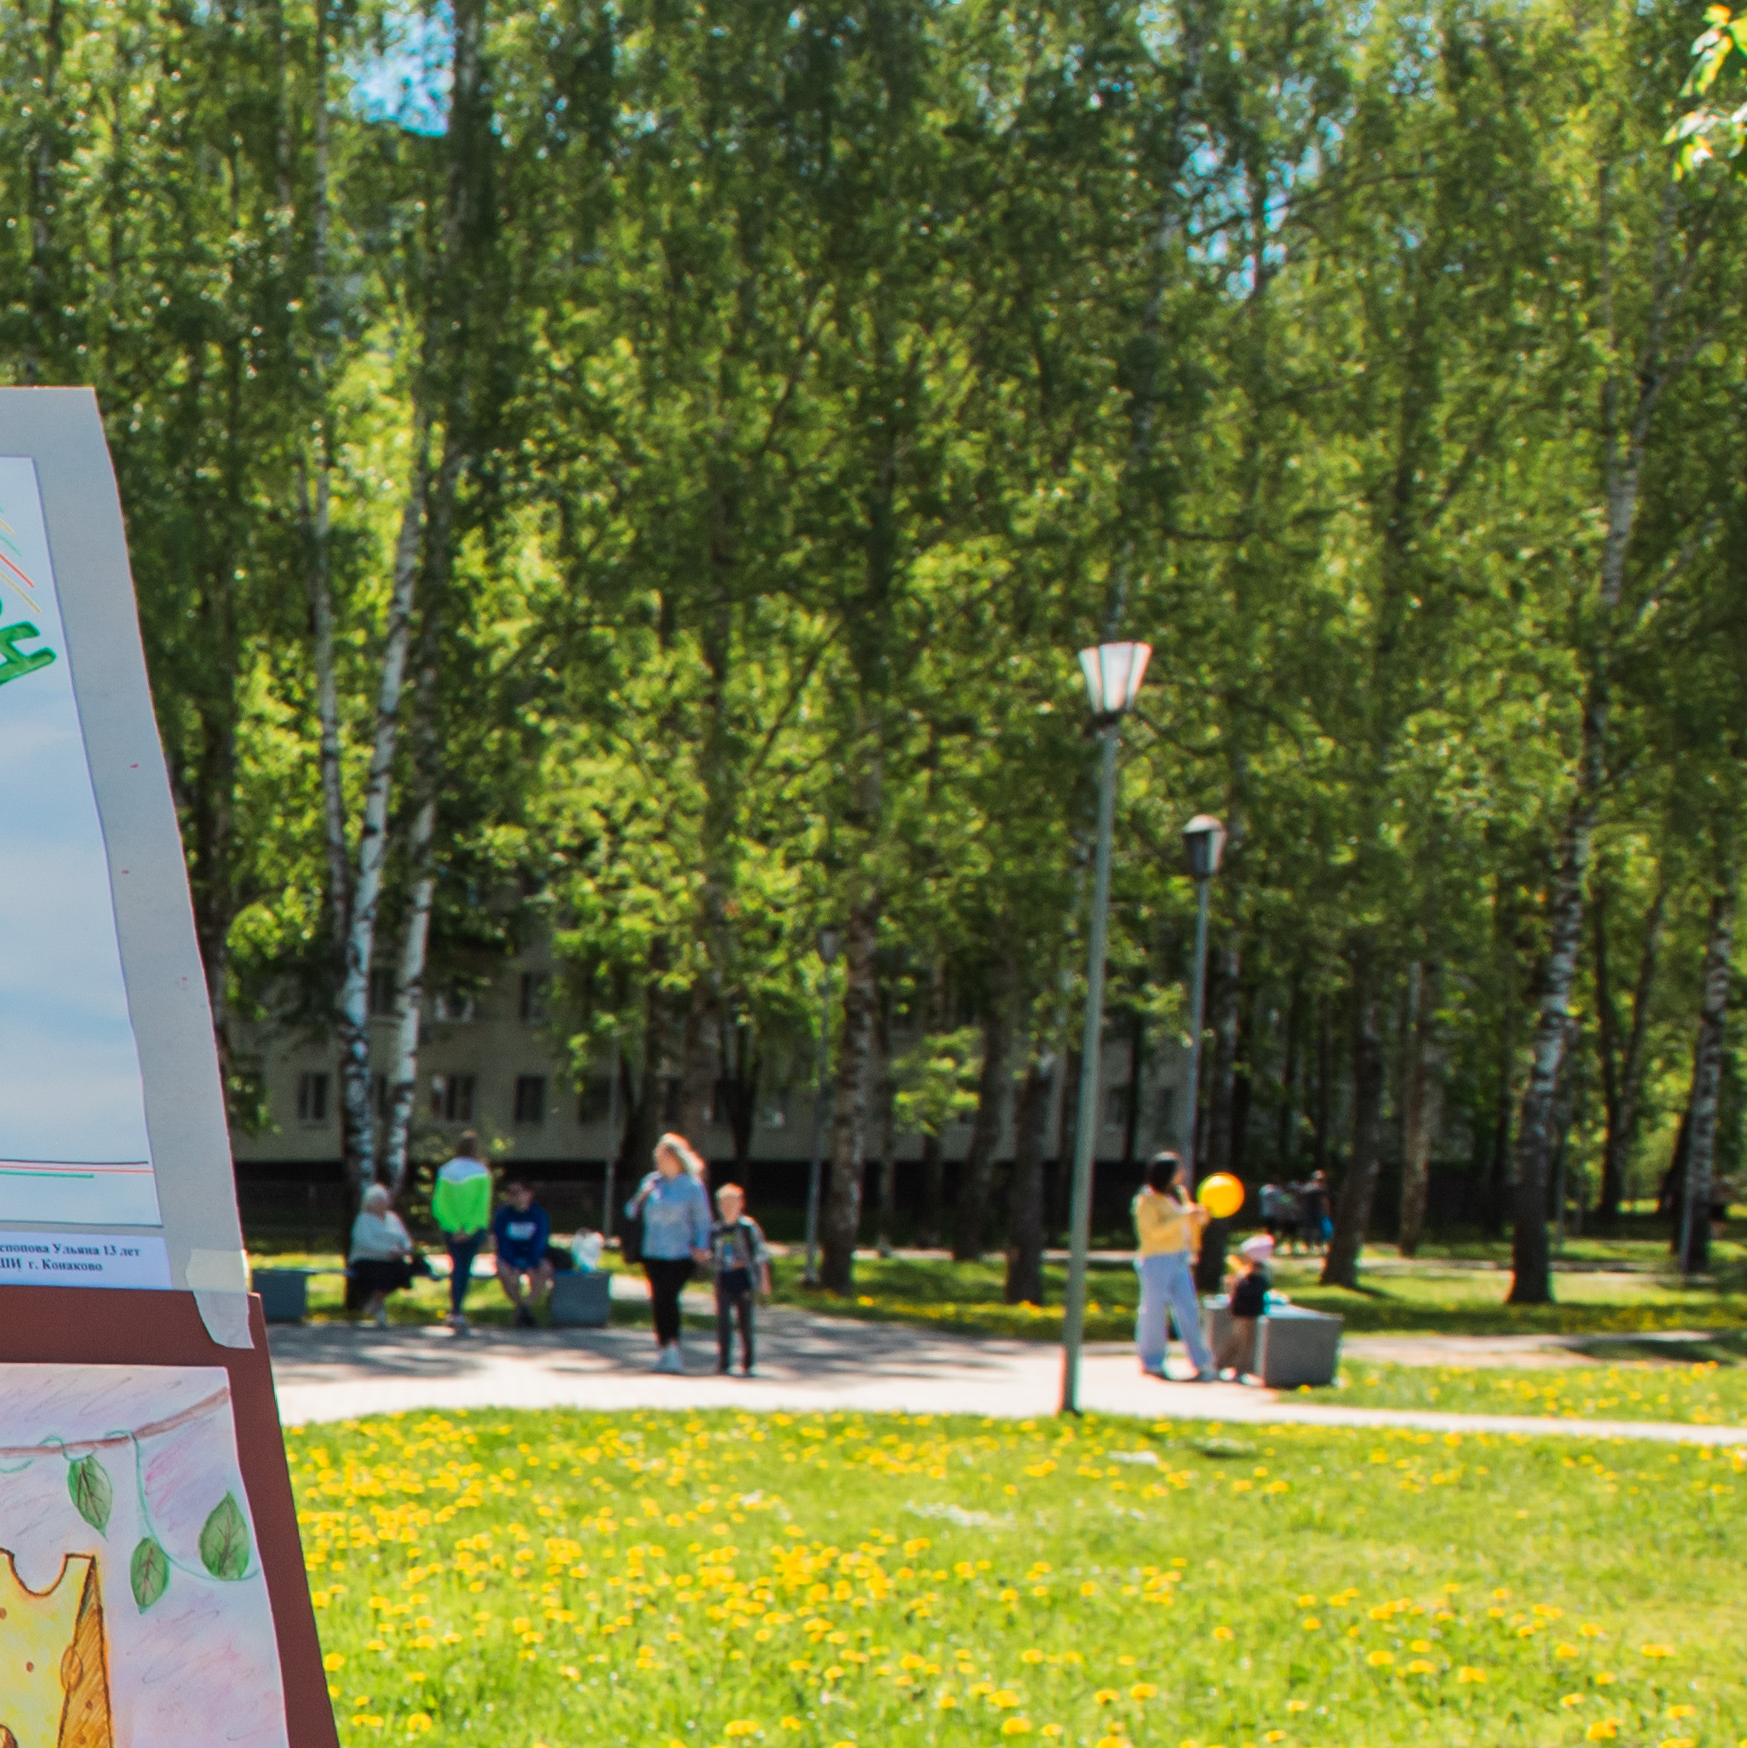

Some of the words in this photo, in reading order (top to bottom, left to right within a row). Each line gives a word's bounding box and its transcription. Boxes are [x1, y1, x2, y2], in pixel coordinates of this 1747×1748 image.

[52, 1243, 99, 1255] Ульяна
[104, 1245, 117, 1256] 13
[119, 1248, 140, 1257] лет
[28, 1261, 38, 1270] г.
[42, 1258, 103, 1271] Конаково
